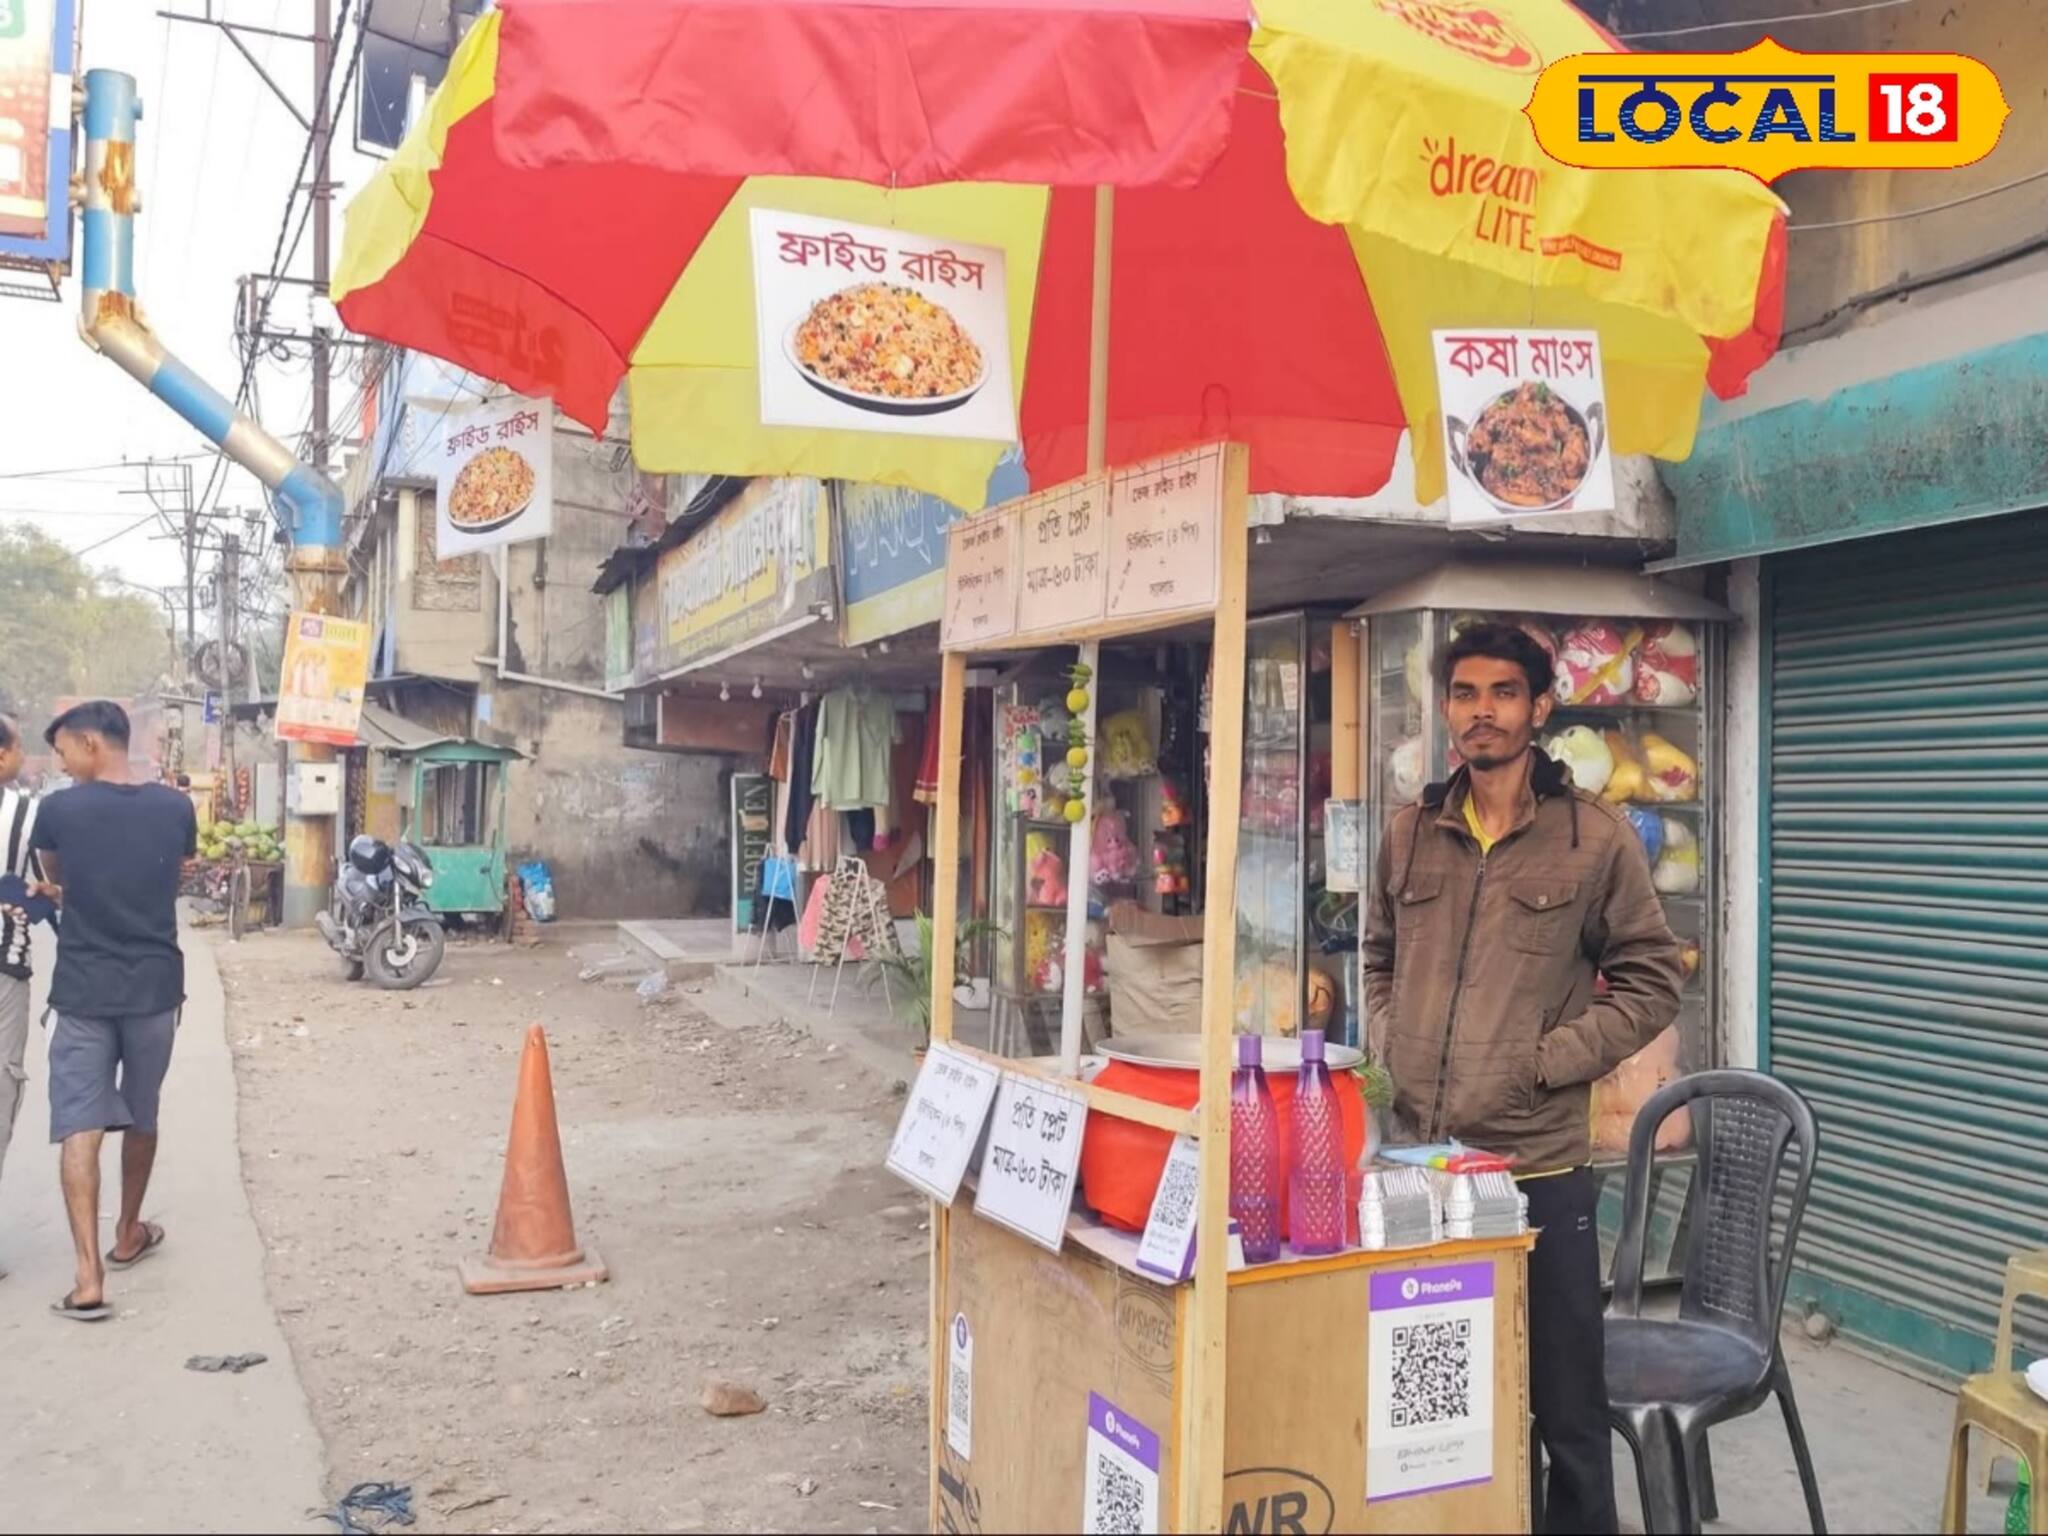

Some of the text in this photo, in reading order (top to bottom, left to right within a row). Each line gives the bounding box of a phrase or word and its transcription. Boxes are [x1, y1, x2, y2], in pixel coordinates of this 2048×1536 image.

[1476, 200, 1535, 253] LITE
[777, 231, 985, 290] ফ্রাইড রাইস
[1445, 335, 1594, 379] কষা মাংস
[496, 410, 539, 440] রাইস
